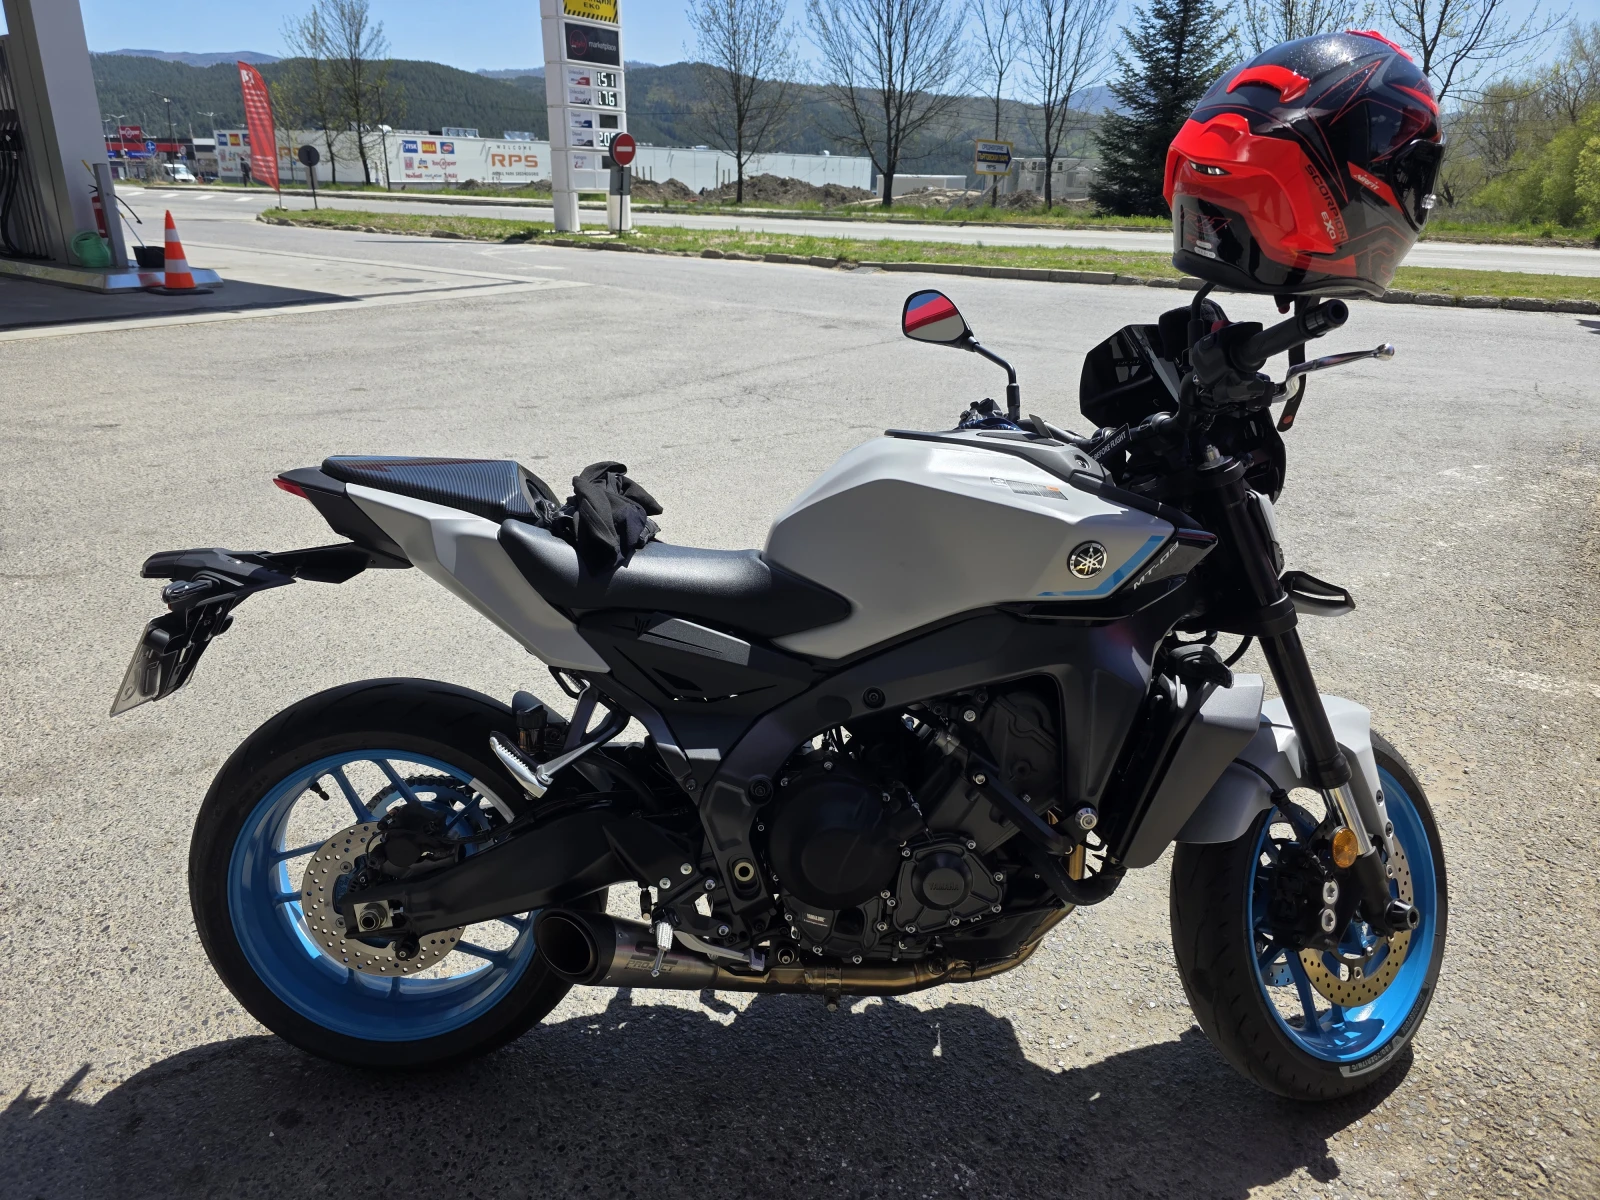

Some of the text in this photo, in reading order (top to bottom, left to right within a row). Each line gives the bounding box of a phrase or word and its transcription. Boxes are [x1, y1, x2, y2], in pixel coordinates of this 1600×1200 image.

[491, 153, 539, 168] RPS
[1305, 164, 1347, 240] SCORPION
[1321, 211, 1337, 240] EXO
[1093, 431, 1126, 460] BEFORE FLIGHT
[1133, 540, 1179, 590] MT-09
[929, 882, 960, 891] YAMAHA
